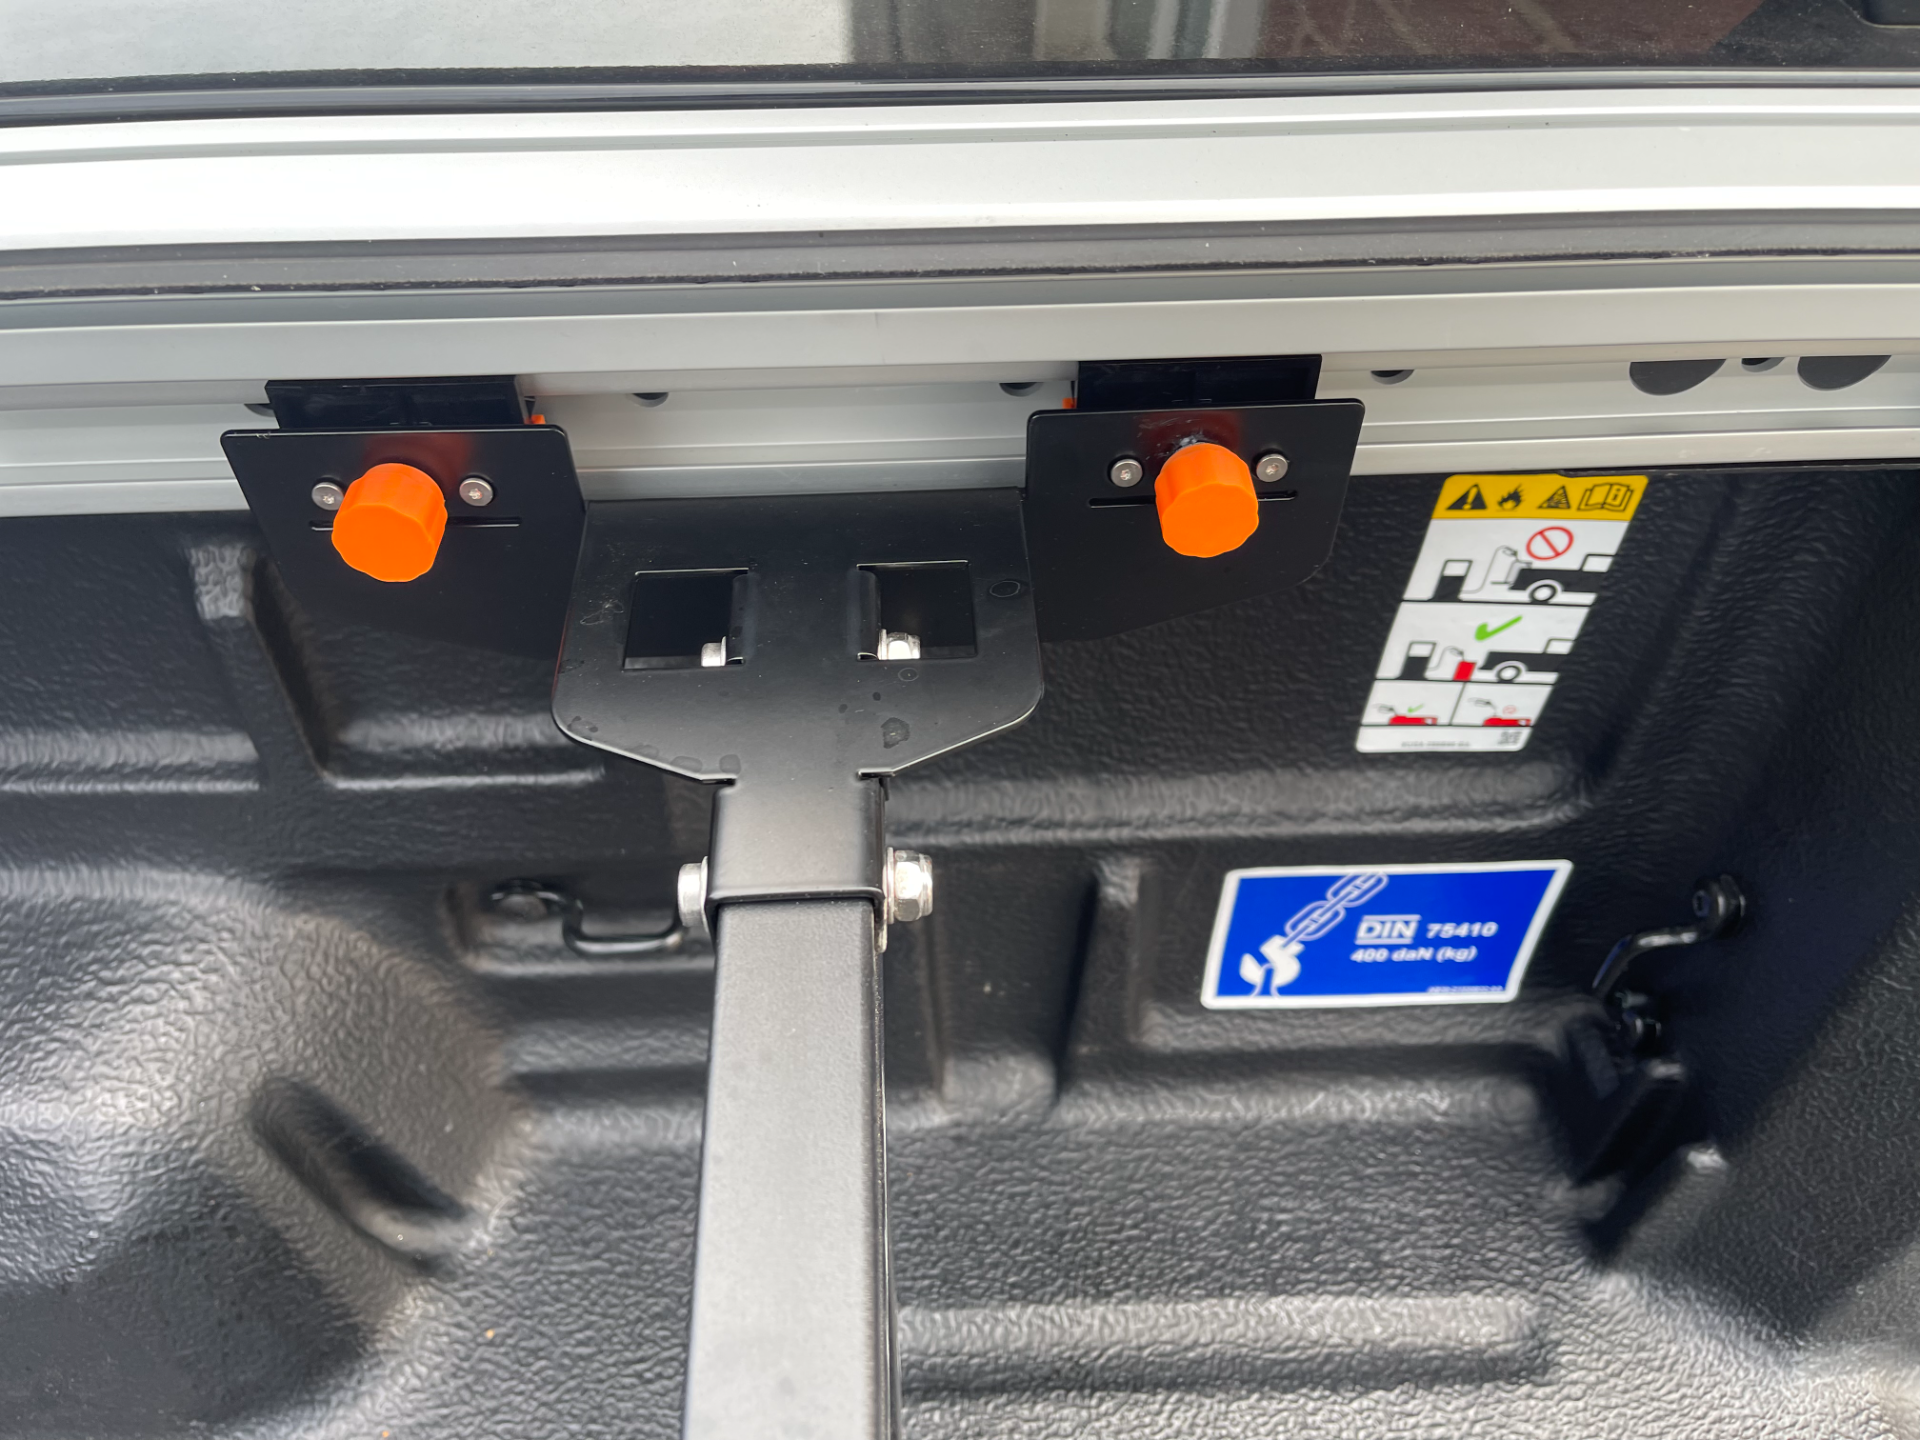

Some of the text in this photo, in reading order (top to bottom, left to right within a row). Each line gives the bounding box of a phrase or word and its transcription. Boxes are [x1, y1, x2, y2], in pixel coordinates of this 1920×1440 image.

[1356, 920, 1499, 939] DIN 75410
[1350, 946, 1478, 963] 400 daN (kg)
